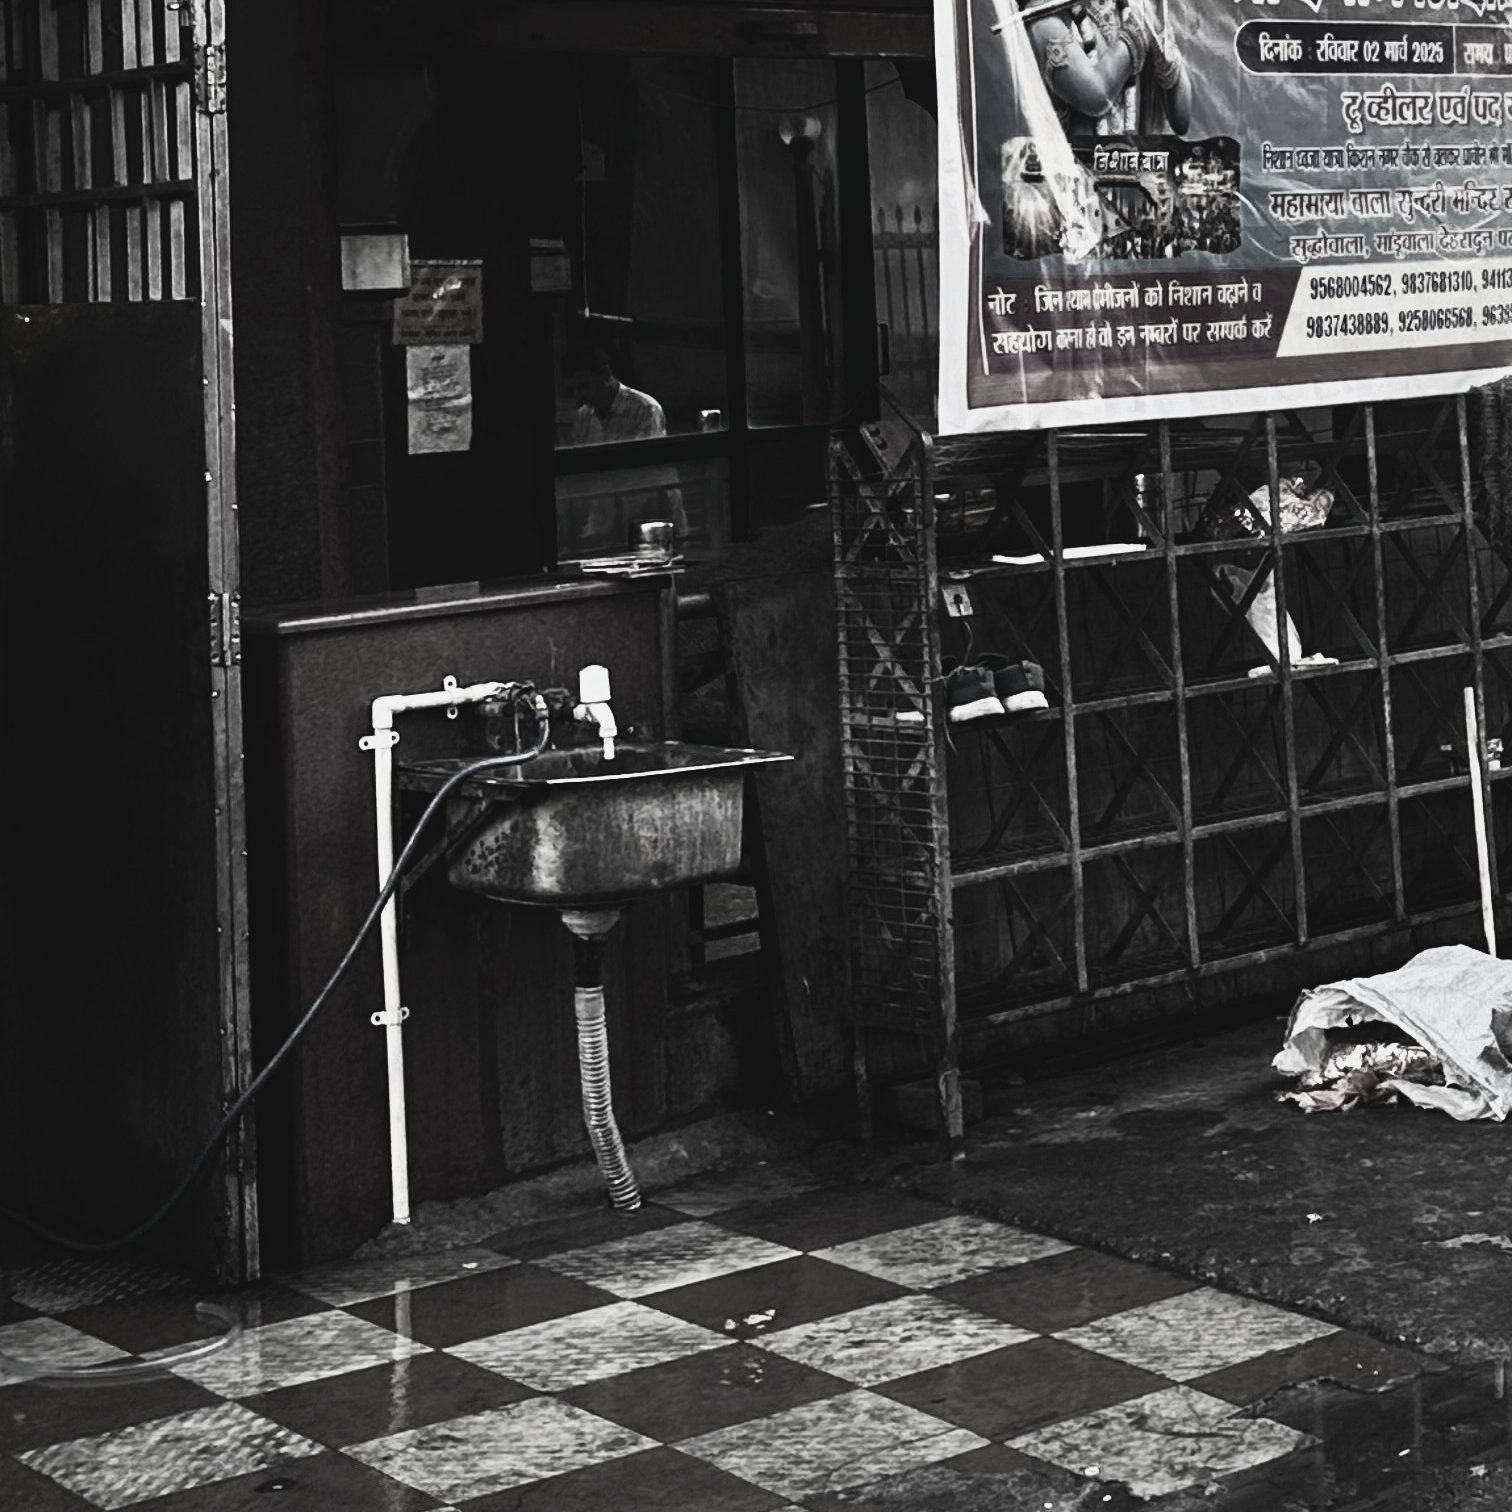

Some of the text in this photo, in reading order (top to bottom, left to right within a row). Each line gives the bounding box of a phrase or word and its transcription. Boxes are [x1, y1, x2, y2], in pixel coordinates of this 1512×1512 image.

[1258, 32, 1444, 64] दिनांक रविवार 02 मार्च 2025
[1463, 42, 1494, 65] समय
[1341, 91, 1363, 133] टू
[1364, 83, 1433, 125] व्हीलर
[1472, 91, 1502, 127] पद
[1268, 190, 1346, 221] महामाया
[1451, 178, 1500, 213] मन्दिर
[987, 286, 1017, 316] नोट
[1034, 284, 1063, 314] जिन
[1144, 279, 1163, 307] को
[1168, 279, 1212, 307] निशान
[1252, 282, 1262, 303] व
[992, 323, 1052, 354] सहयोग
[1116, 325, 1136, 348] इन
[1138, 317, 1179, 347] नम्बरों
[1182, 322, 1201, 343] पर
[1251, 312, 1273, 339] करें
